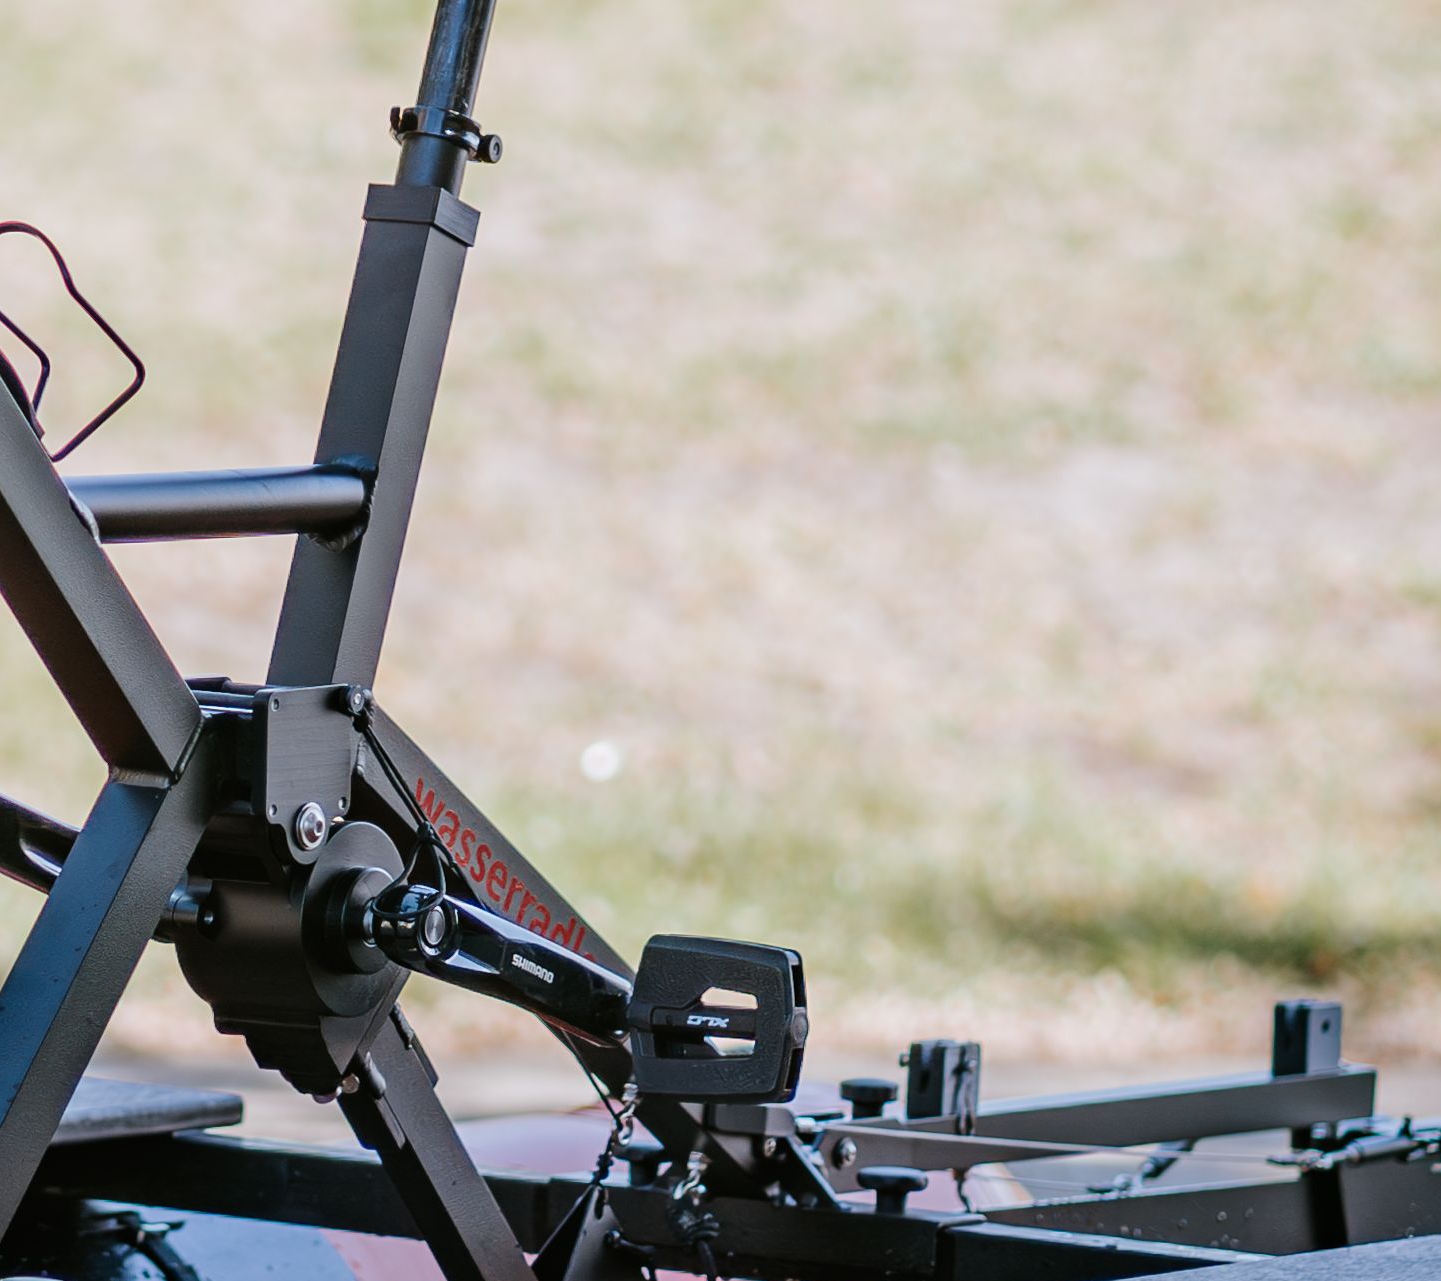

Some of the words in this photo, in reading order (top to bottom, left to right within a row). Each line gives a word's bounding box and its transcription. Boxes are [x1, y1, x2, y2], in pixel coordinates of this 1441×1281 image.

[415, 777, 596, 962] wasserradl
[511, 953, 555, 984] SHIMANO
[686, 1014, 730, 1028] XLC
